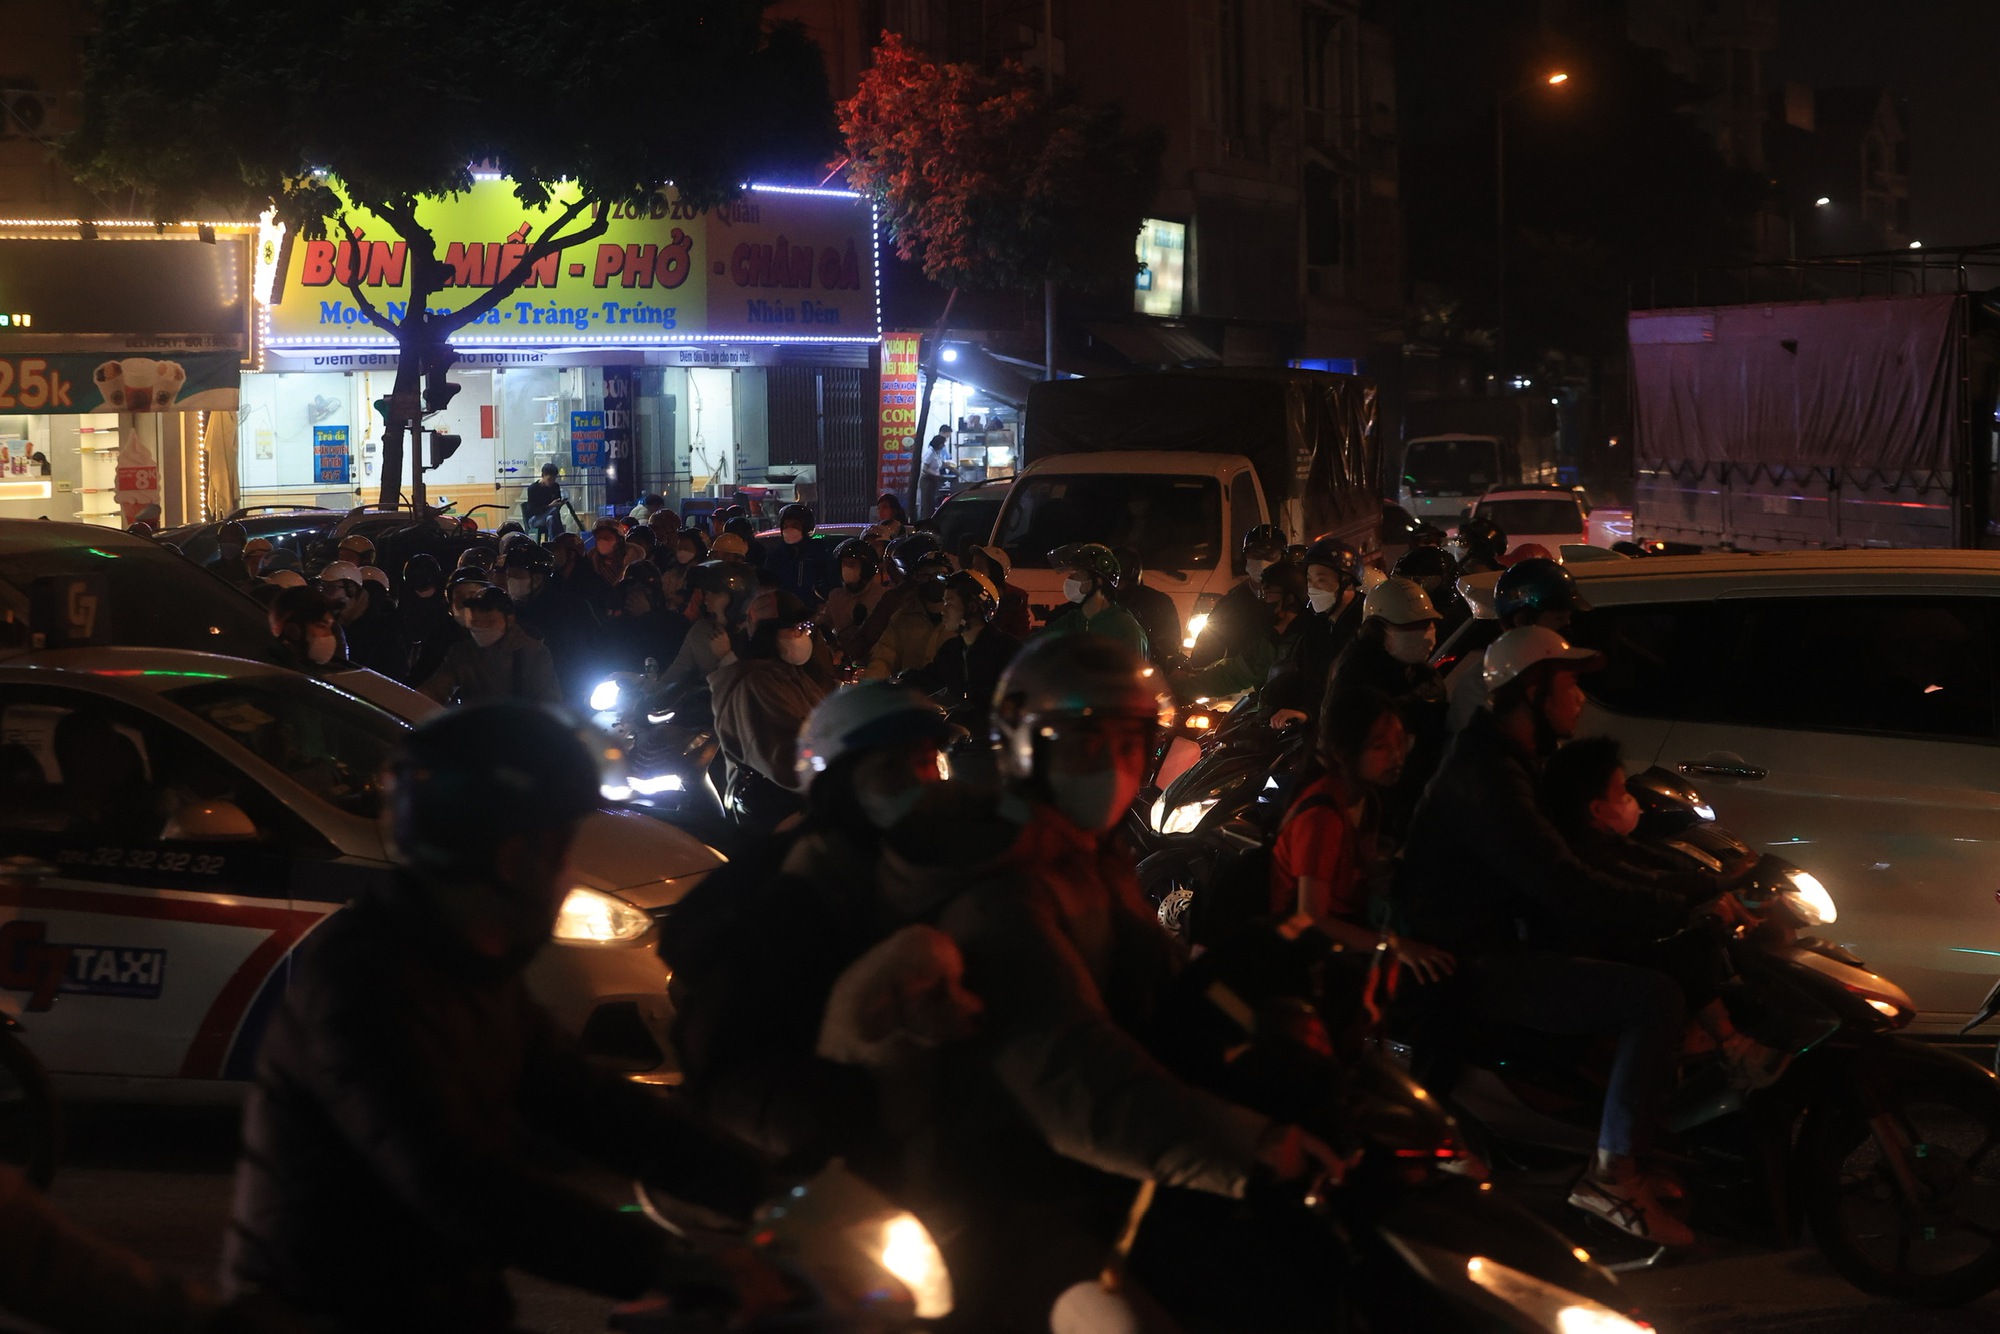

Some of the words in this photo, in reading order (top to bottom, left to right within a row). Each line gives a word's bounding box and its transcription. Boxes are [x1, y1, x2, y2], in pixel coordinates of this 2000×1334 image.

[302, 226, 408, 287] BÚN
[443, 222, 561, 288] MIẾN
[593, 228, 693, 289] PHỞ
[731, 235, 813, 288] CHÂN
[514, 299, 589, 330] Tràng
[602, 301, 677, 330] Trứng
[747, 299, 795, 329] Nhậu
[800, 299, 840, 324] Đêm
[720, 350, 729, 362] cho
[882, 409, 916, 423] CƠM
[882, 425, 916, 436] PHỞ
[91, 847, 124, 867] 32
[125, 850, 157, 870] 32
[157, 852, 192, 872] 32
[190, 854, 226, 876] 32
[73, 949, 162, 985] TAXI
